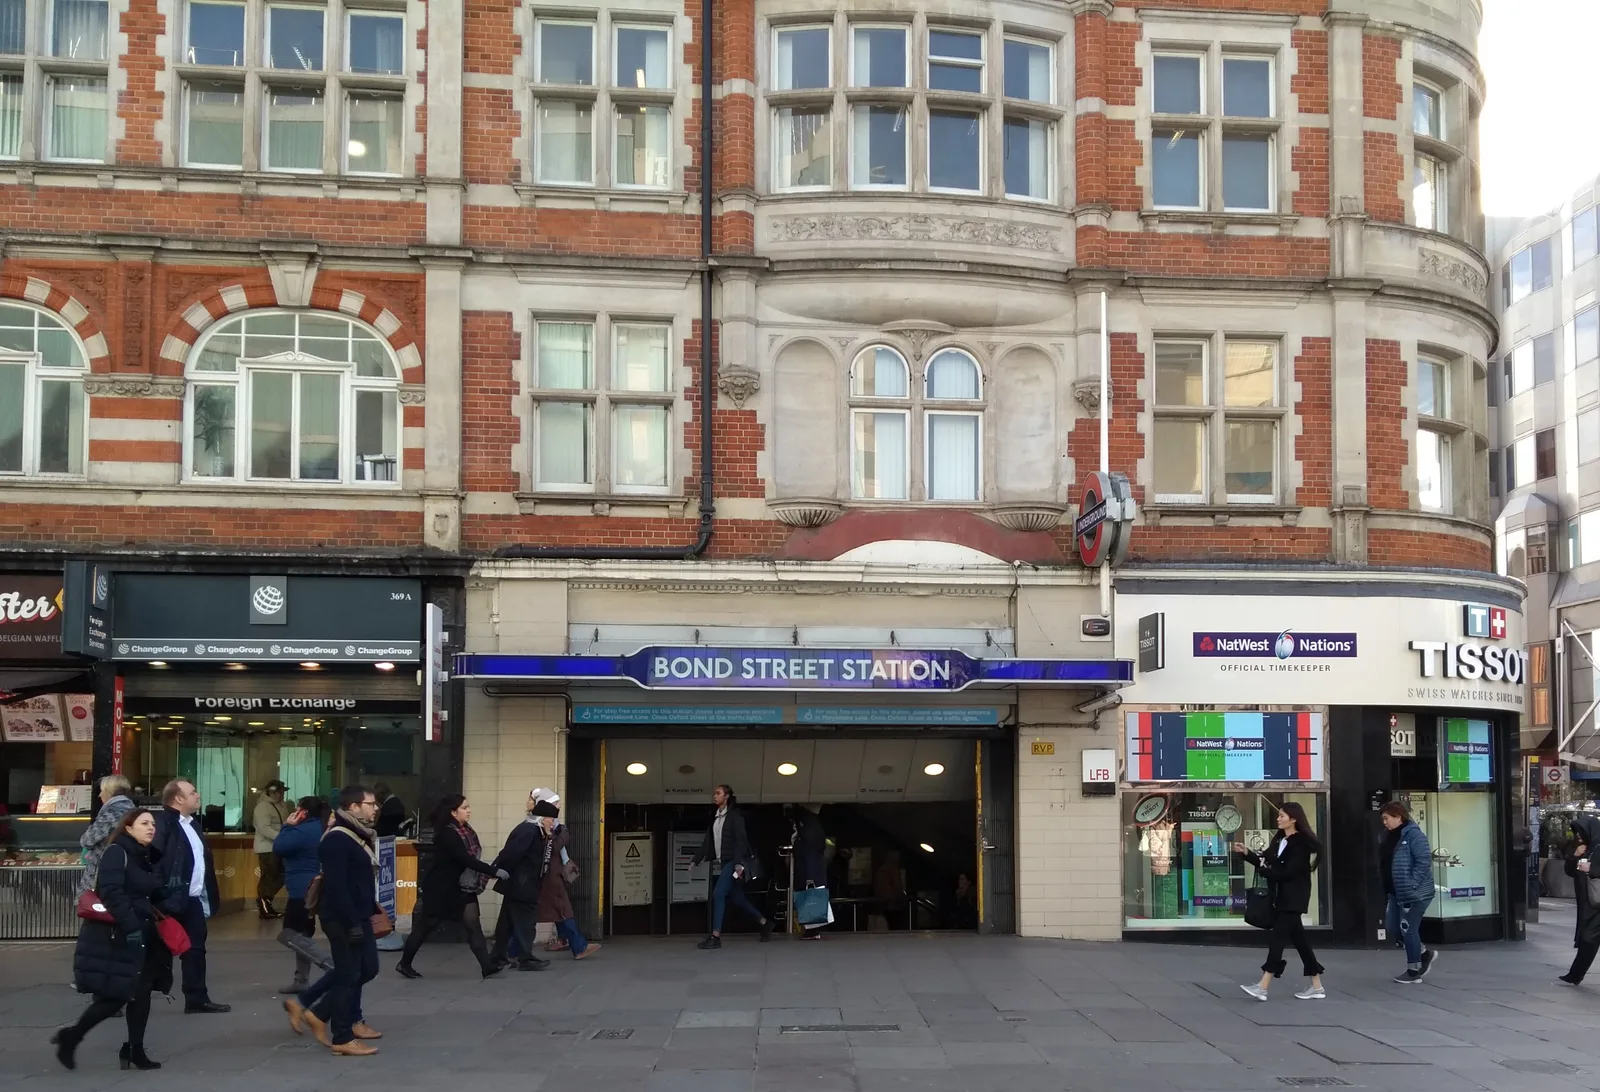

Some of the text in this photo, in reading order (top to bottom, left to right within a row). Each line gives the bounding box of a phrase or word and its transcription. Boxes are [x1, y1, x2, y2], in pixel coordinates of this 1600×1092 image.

[1077, 505, 1107, 532] UNDERGROUND
[89, 615, 104, 627] Foreign
[89, 627, 107, 640] Exchange
[89, 638, 105, 650] Services
[1140, 636, 1155, 649] TISSOT
[1216, 638, 1269, 651] NatWest
[1299, 638, 1351, 651] Nations
[131, 645, 188, 654] ChangeGroup
[207, 645, 264, 655] ChangeGroup
[283, 646, 339, 656] ChangeGroup
[357, 647, 412, 656] ChangeGroup
[1220, 664, 1331, 672] OFFICIAL TIMEKEEPER
[1408, 639, 1529, 685] TISSOT
[654, 657, 950, 681] BOND STREET STATION
[1407, 687, 1446, 699] SWISS
[1451, 688, 1493, 701] WATCHES
[1496, 691, 1513, 703] SINCE
[194, 697, 356, 710] Foreign Exchange
[115, 690, 123, 771] MONEY
[1033, 744, 1053, 753] RVP
[1196, 740, 1262, 748] NatWest Nations
[1089, 768, 1110, 781] LFB
[1140, 802, 1160, 817] TISSOT
